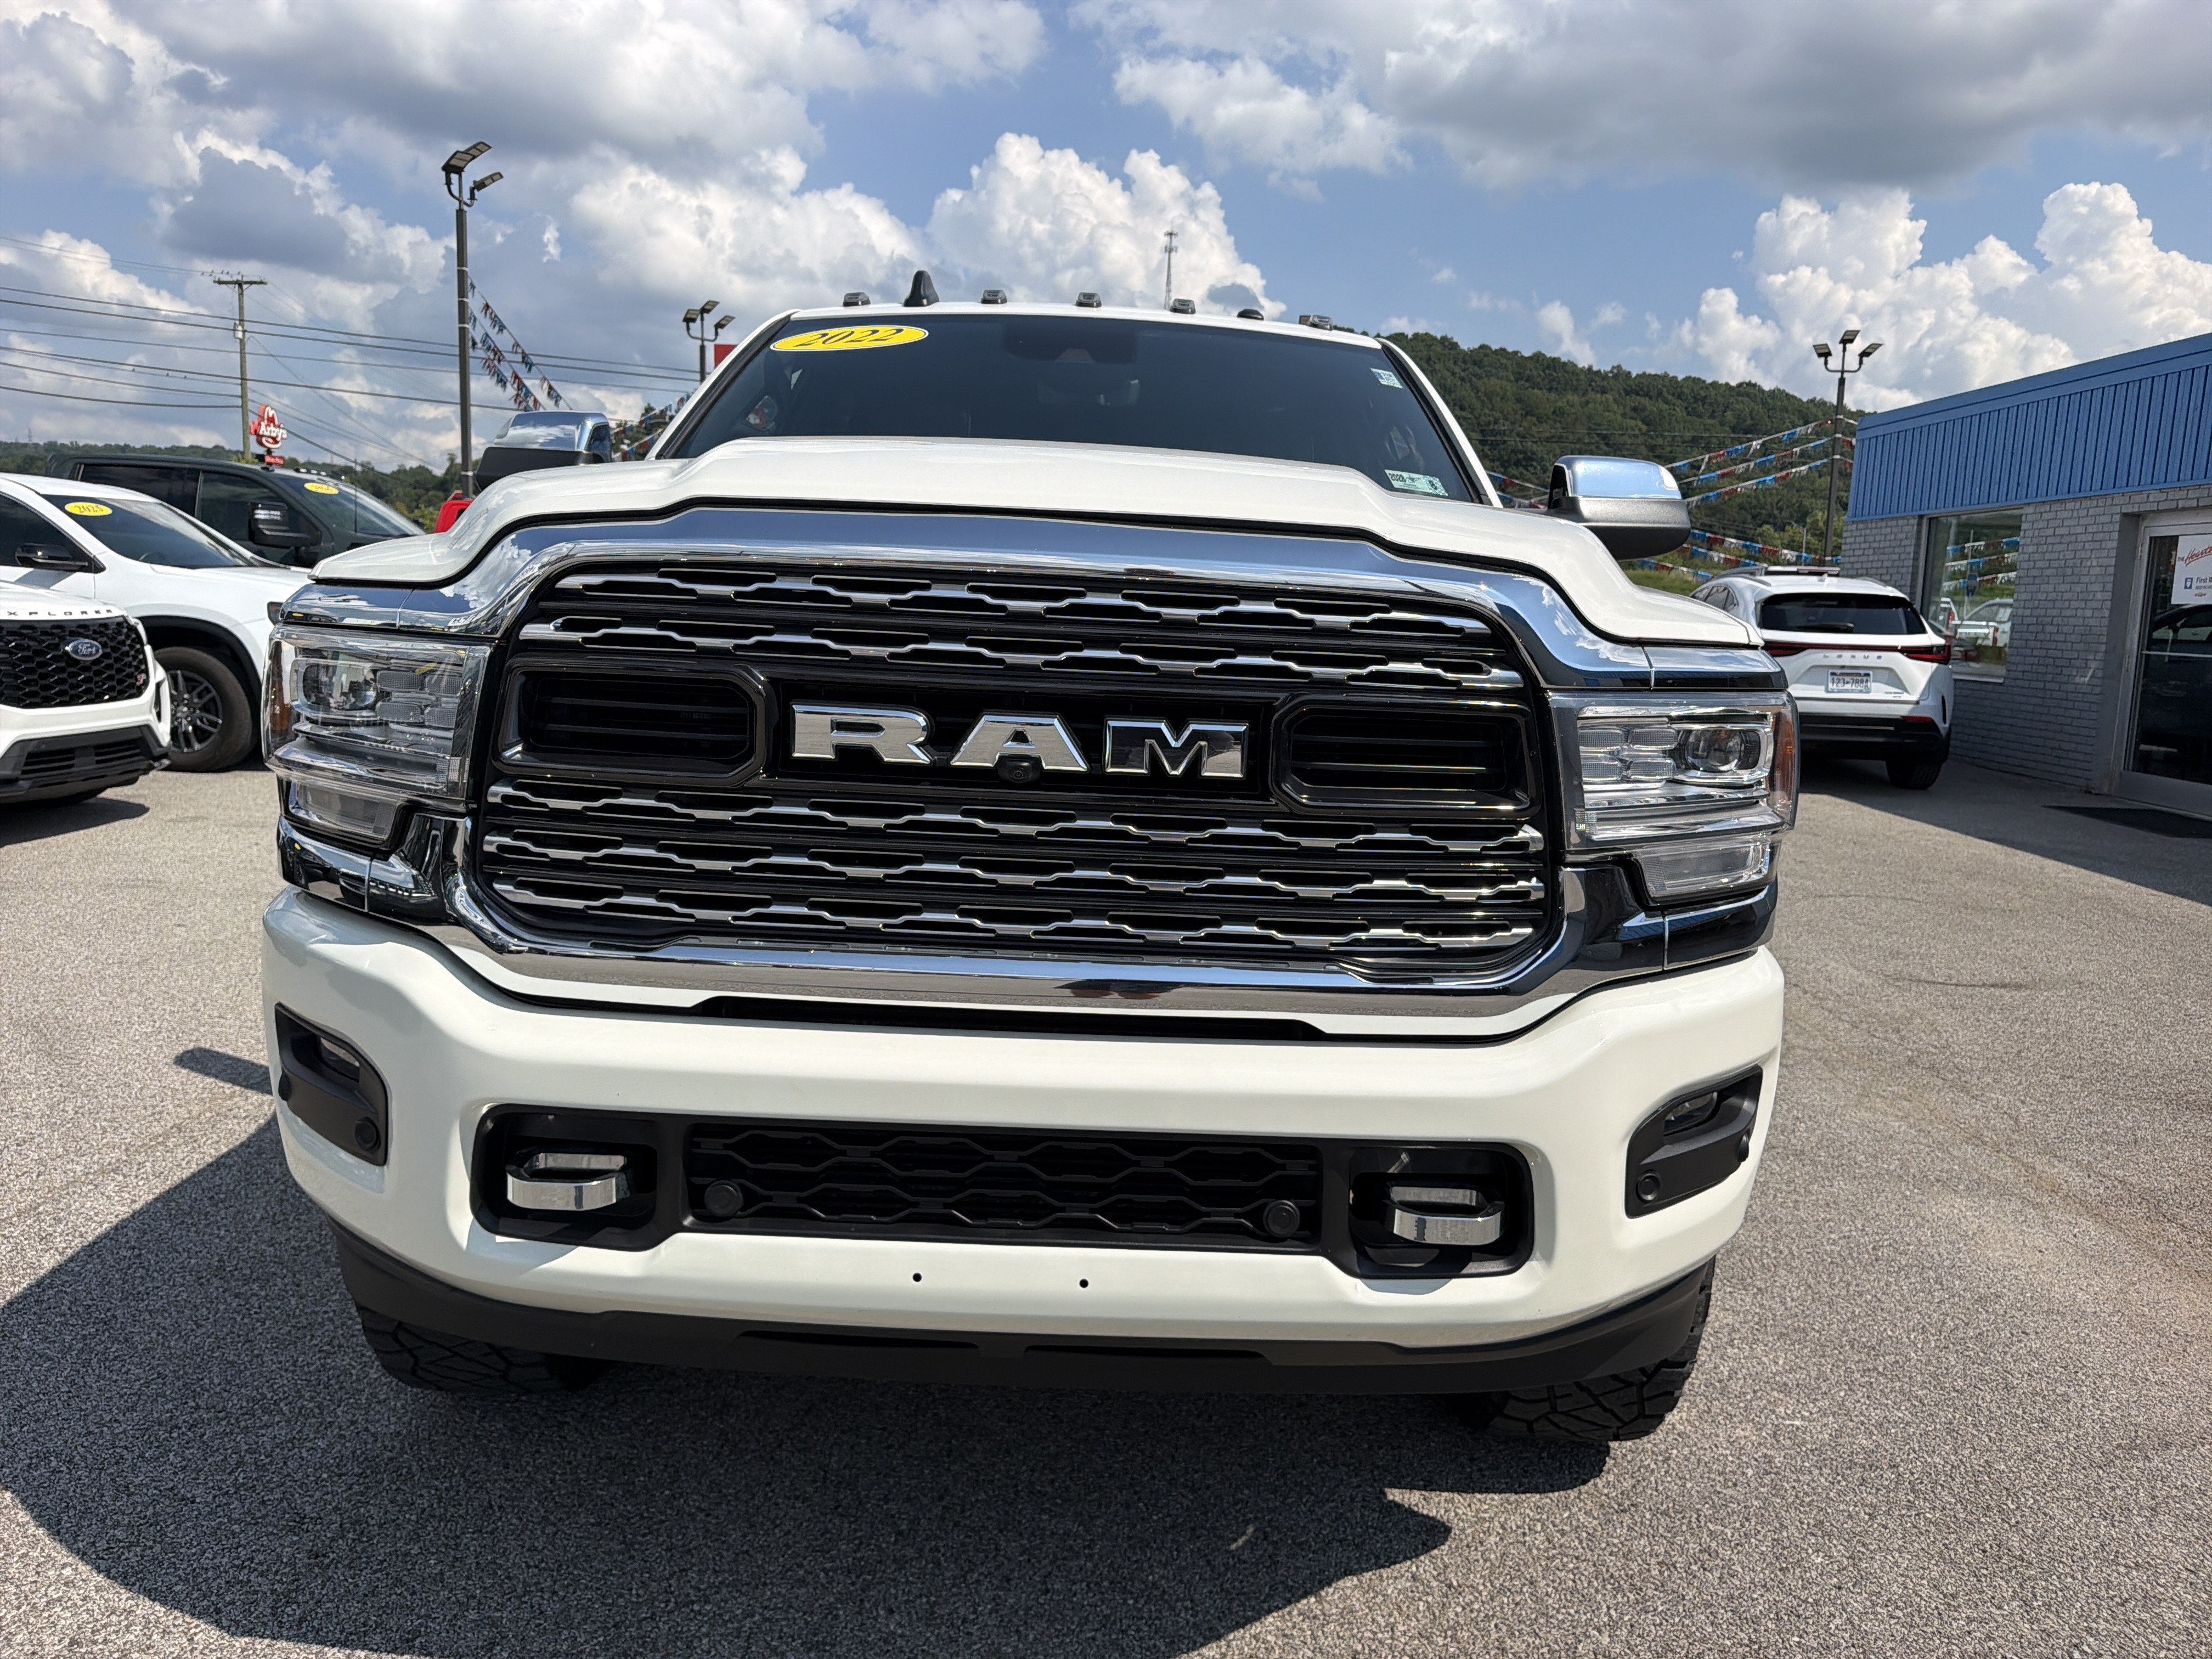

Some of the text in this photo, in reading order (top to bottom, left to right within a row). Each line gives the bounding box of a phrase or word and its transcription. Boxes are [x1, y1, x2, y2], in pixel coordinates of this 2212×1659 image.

[793, 328, 904, 348] 2022
[259, 421, 287, 442] Arby's
[78, 643, 96, 655] Ford
[791, 703, 1250, 778] RAM
